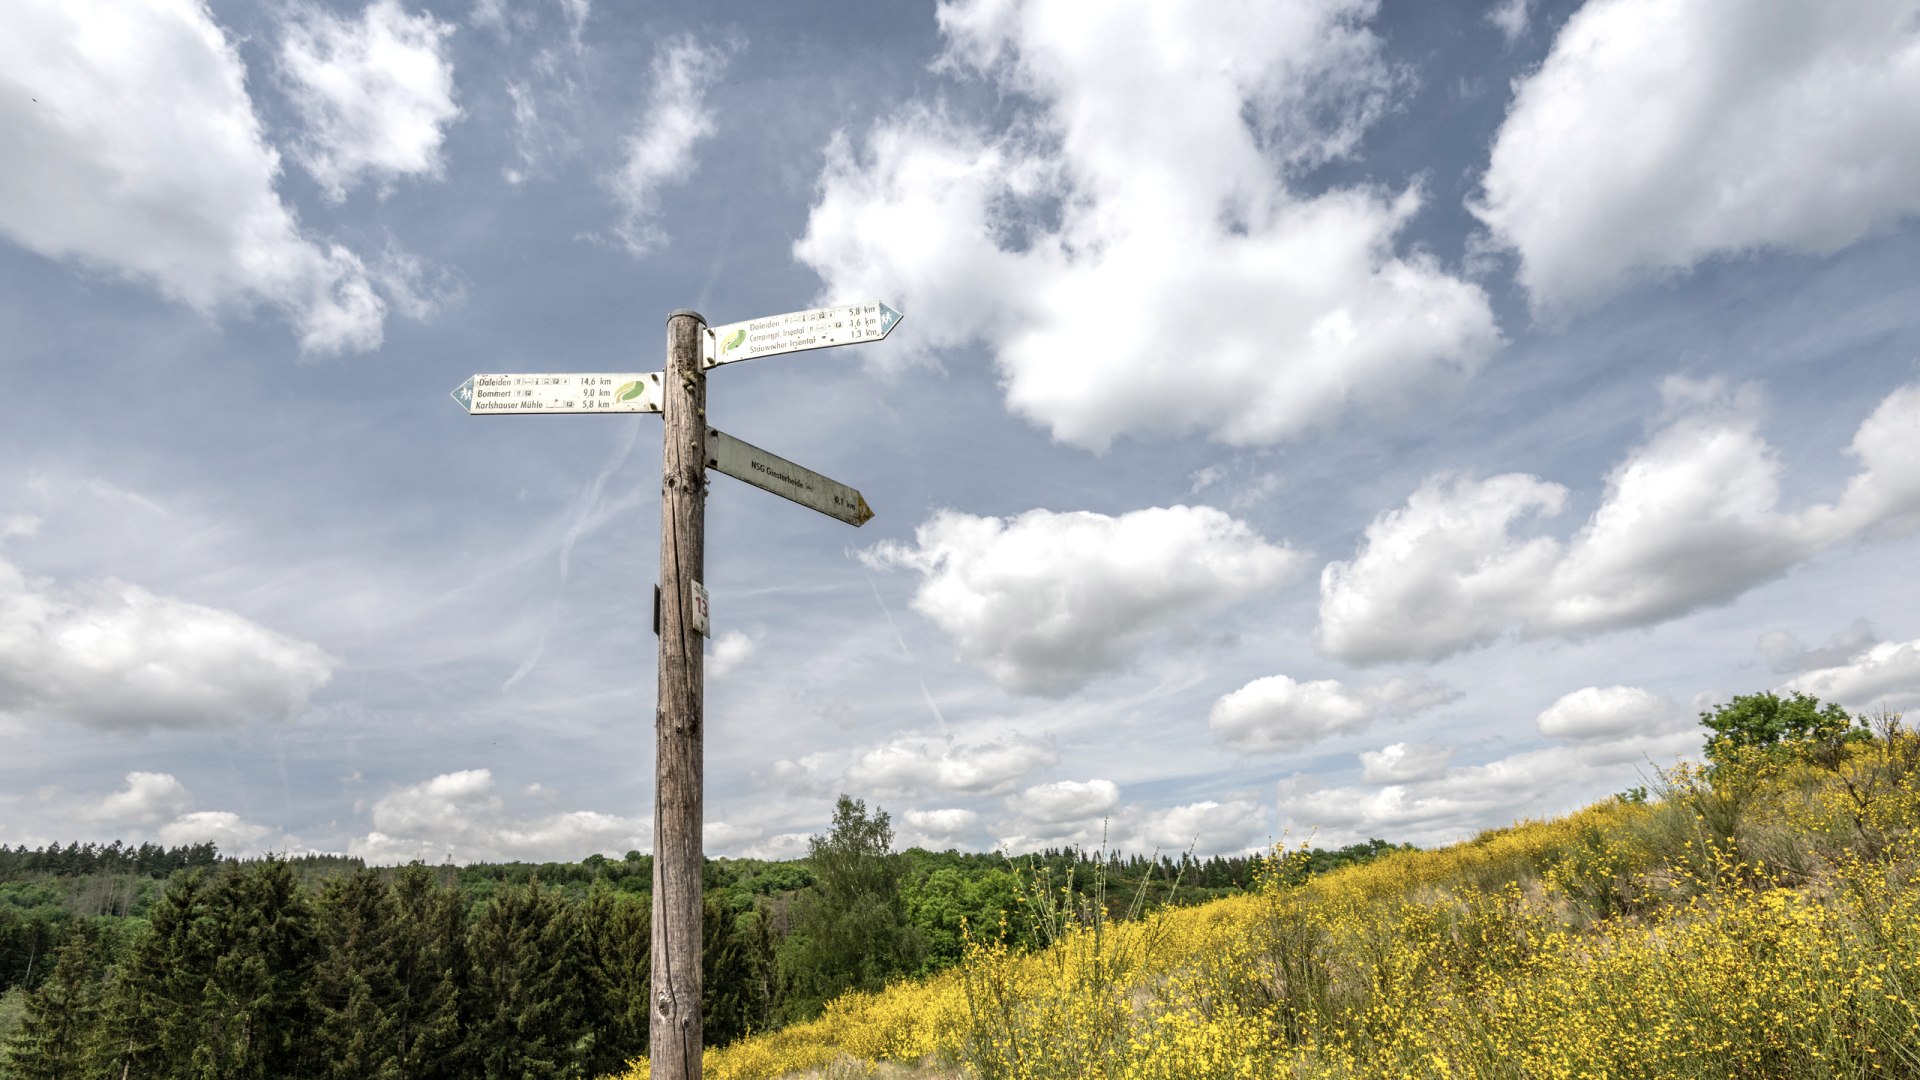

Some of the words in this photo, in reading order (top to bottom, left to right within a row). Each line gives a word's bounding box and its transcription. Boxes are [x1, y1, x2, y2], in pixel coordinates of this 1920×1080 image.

[750, 320, 780, 331] Daleiden
[849, 308, 860, 316] 5,8
[790, 336, 816, 347] Irsental
[851, 330, 862, 339] 1,3
[479, 378, 512, 386] Daleiden
[581, 378, 596, 386] 14,6
[600, 377, 611, 385] km
[583, 388, 595, 398] 9,0
[599, 388, 610, 396] km
[476, 401, 518, 409] Karlshauser
[582, 400, 594, 410] 5,8
[598, 400, 610, 408] km
[751, 460, 765, 473] NSG
[767, 468, 804, 489] Ginsterheide
[846, 500, 856, 510] km
[696, 596, 708, 618] 13
